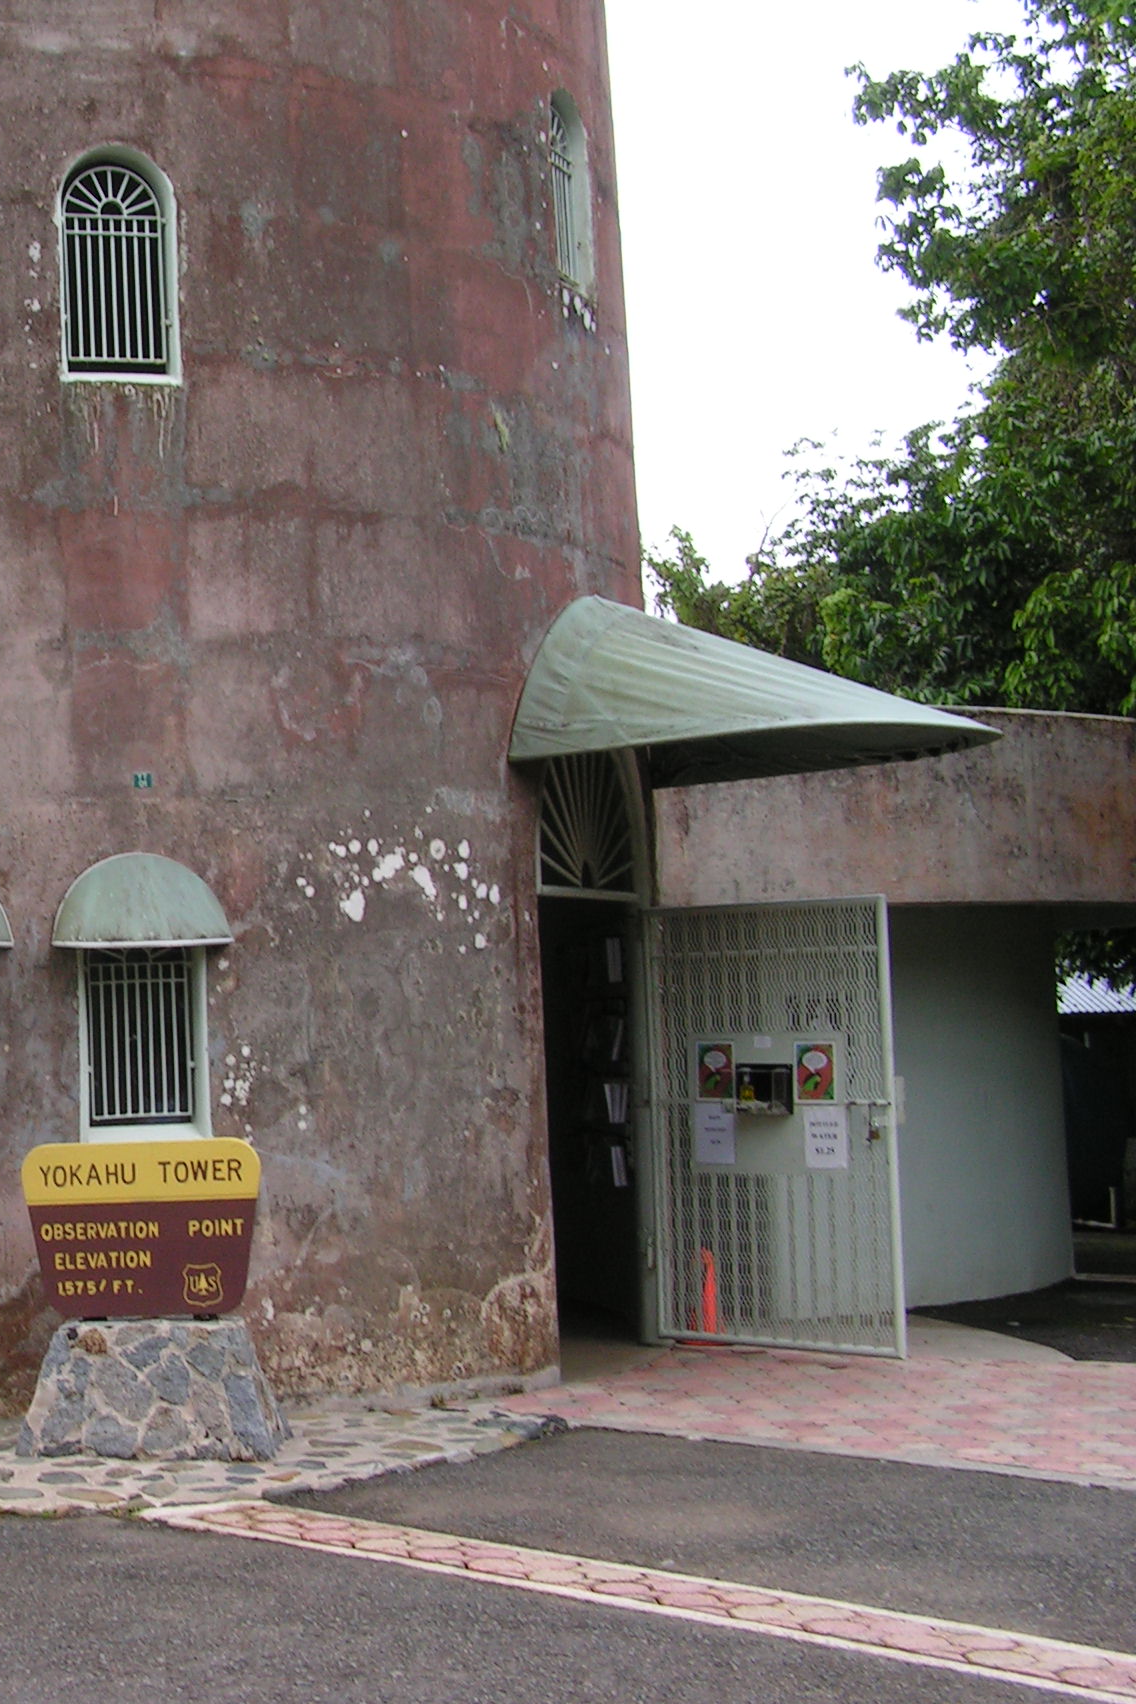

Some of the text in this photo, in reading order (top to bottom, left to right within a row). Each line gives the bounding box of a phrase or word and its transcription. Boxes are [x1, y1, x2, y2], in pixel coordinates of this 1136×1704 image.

[39, 1158, 243, 1188] YOKAHU TOWER
[40, 1218, 244, 1241] OBSERVATION POINT
[54, 1250, 152, 1270] ELEVATION
